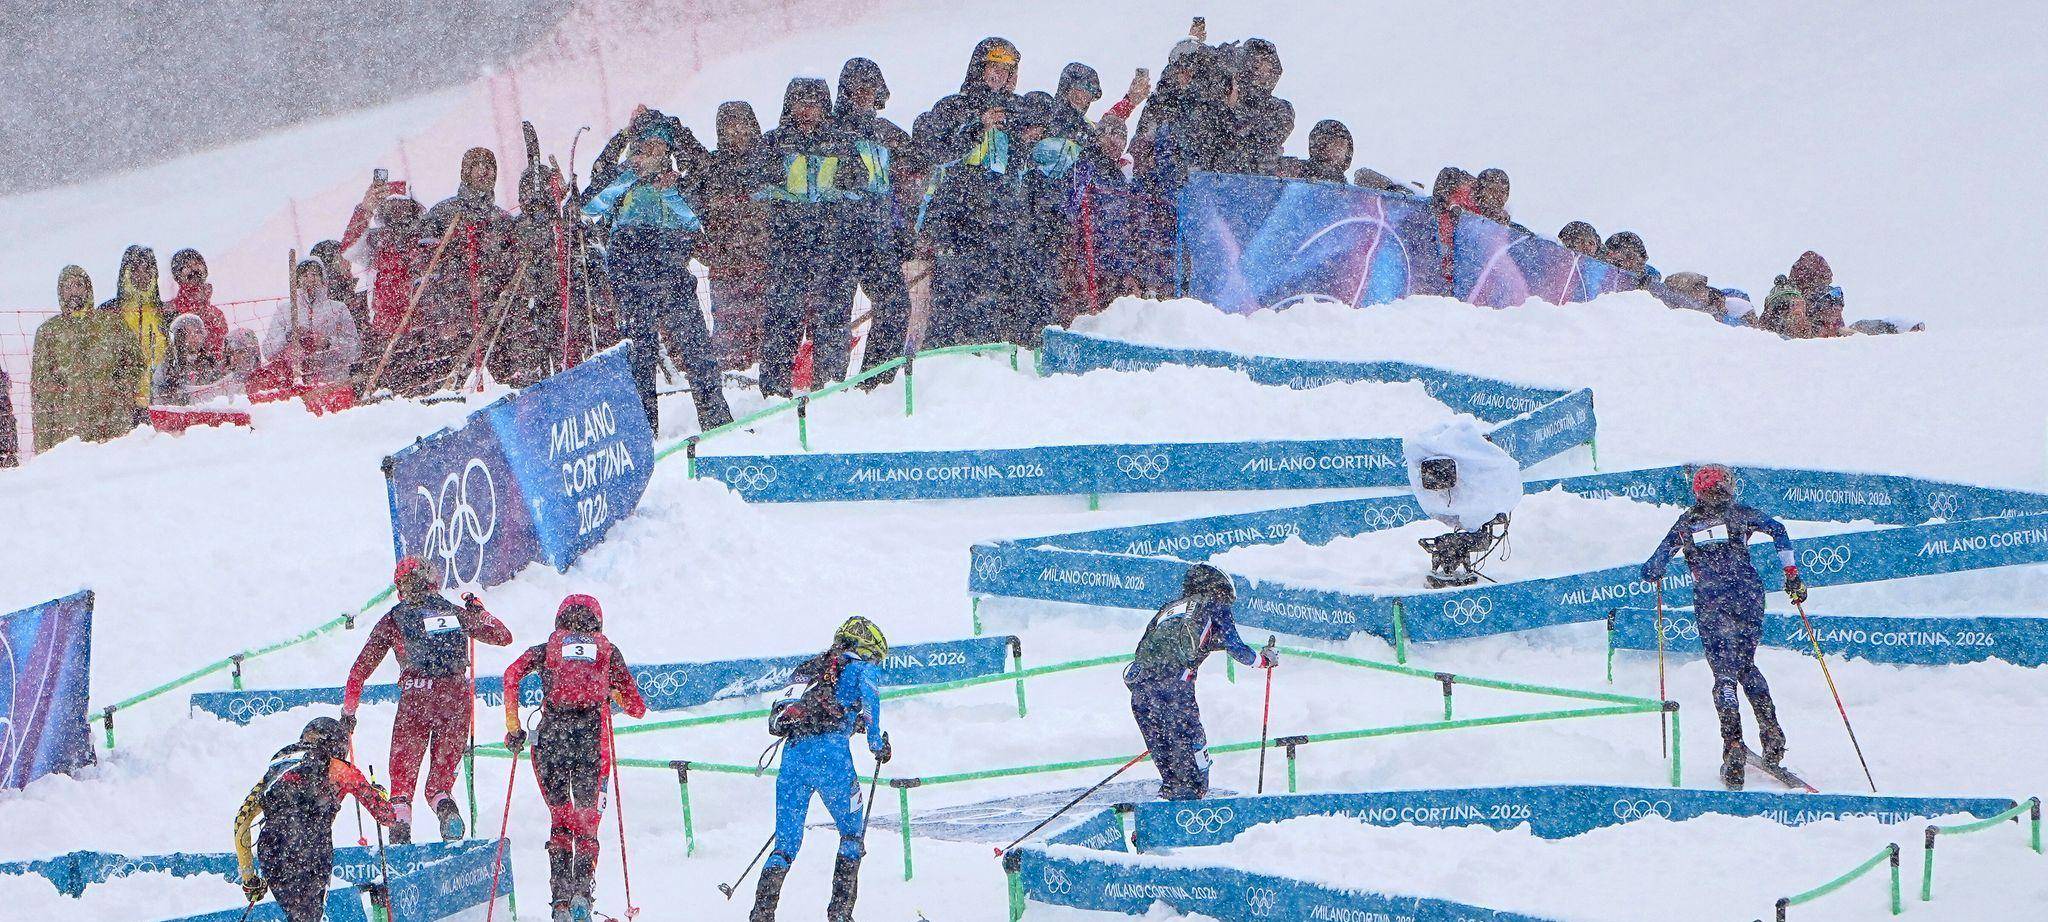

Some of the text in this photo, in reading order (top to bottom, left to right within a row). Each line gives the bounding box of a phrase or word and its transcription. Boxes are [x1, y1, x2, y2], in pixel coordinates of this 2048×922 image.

[1468, 392, 1505, 409] MILANO
[549, 401, 635, 536] MILANO CORTINA 2026
[1240, 456, 1316, 472] MILANO
[1319, 454, 1396, 471] CORTINA
[848, 464, 1044, 484] MILANO CORTINA 2026
[1622, 484, 1656, 499] 2026
[1783, 487, 1892, 506] MILANO CORTINA 2026
[1125, 523, 1300, 555] MILANO CORTINA 2026
[1706, 529, 1714, 539] 1
[1917, 528, 2048, 557] MILANO CORTIN
[1037, 568, 1145, 591] MILANO CORTINA 2026
[1560, 583, 1626, 605] MILANO
[1247, 597, 1356, 625] MILANO CORTINA 2026
[437, 618, 447, 628] 2
[1785, 628, 1995, 647] MILANO CORTINA 2026
[575, 645, 585, 656] 3
[928, 652, 966, 667] 2026
[404, 676, 433, 690] SUI
[785, 687, 794, 698] 4
[1400, 806, 1483, 822] CORTINA
[1490, 804, 1531, 820] 2026
[332, 863, 404, 881] ORTINA
[1104, 883, 1217, 899] MILANO CORTINA 2026
[1310, 904, 1350, 922] MILANO
